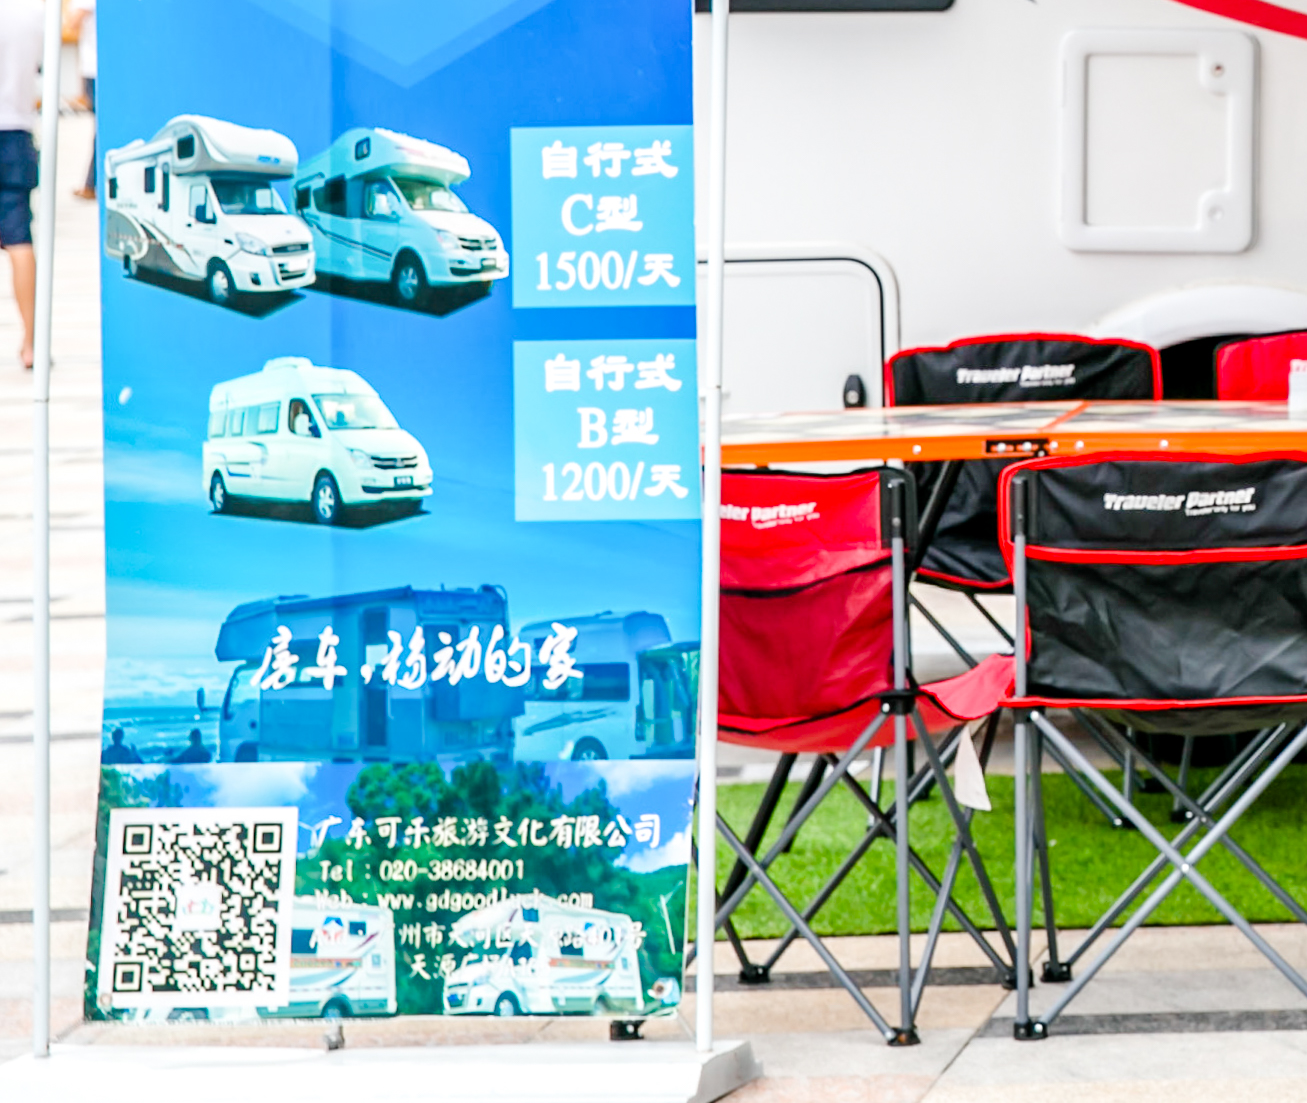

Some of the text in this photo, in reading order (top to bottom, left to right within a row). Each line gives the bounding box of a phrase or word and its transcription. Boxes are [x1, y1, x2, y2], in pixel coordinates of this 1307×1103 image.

[541, 140, 679, 179] 自行式
[561, 193, 643, 236] C型
[535, 250, 681, 291] 1500/天
[544, 353, 683, 392] 自行式
[577, 407, 660, 449] B型
[542, 461, 689, 501] 1200/天
[317, 814, 661, 849] 广东可乐旅游文化有限公司
[379, 858, 525, 882] 020-38684001
